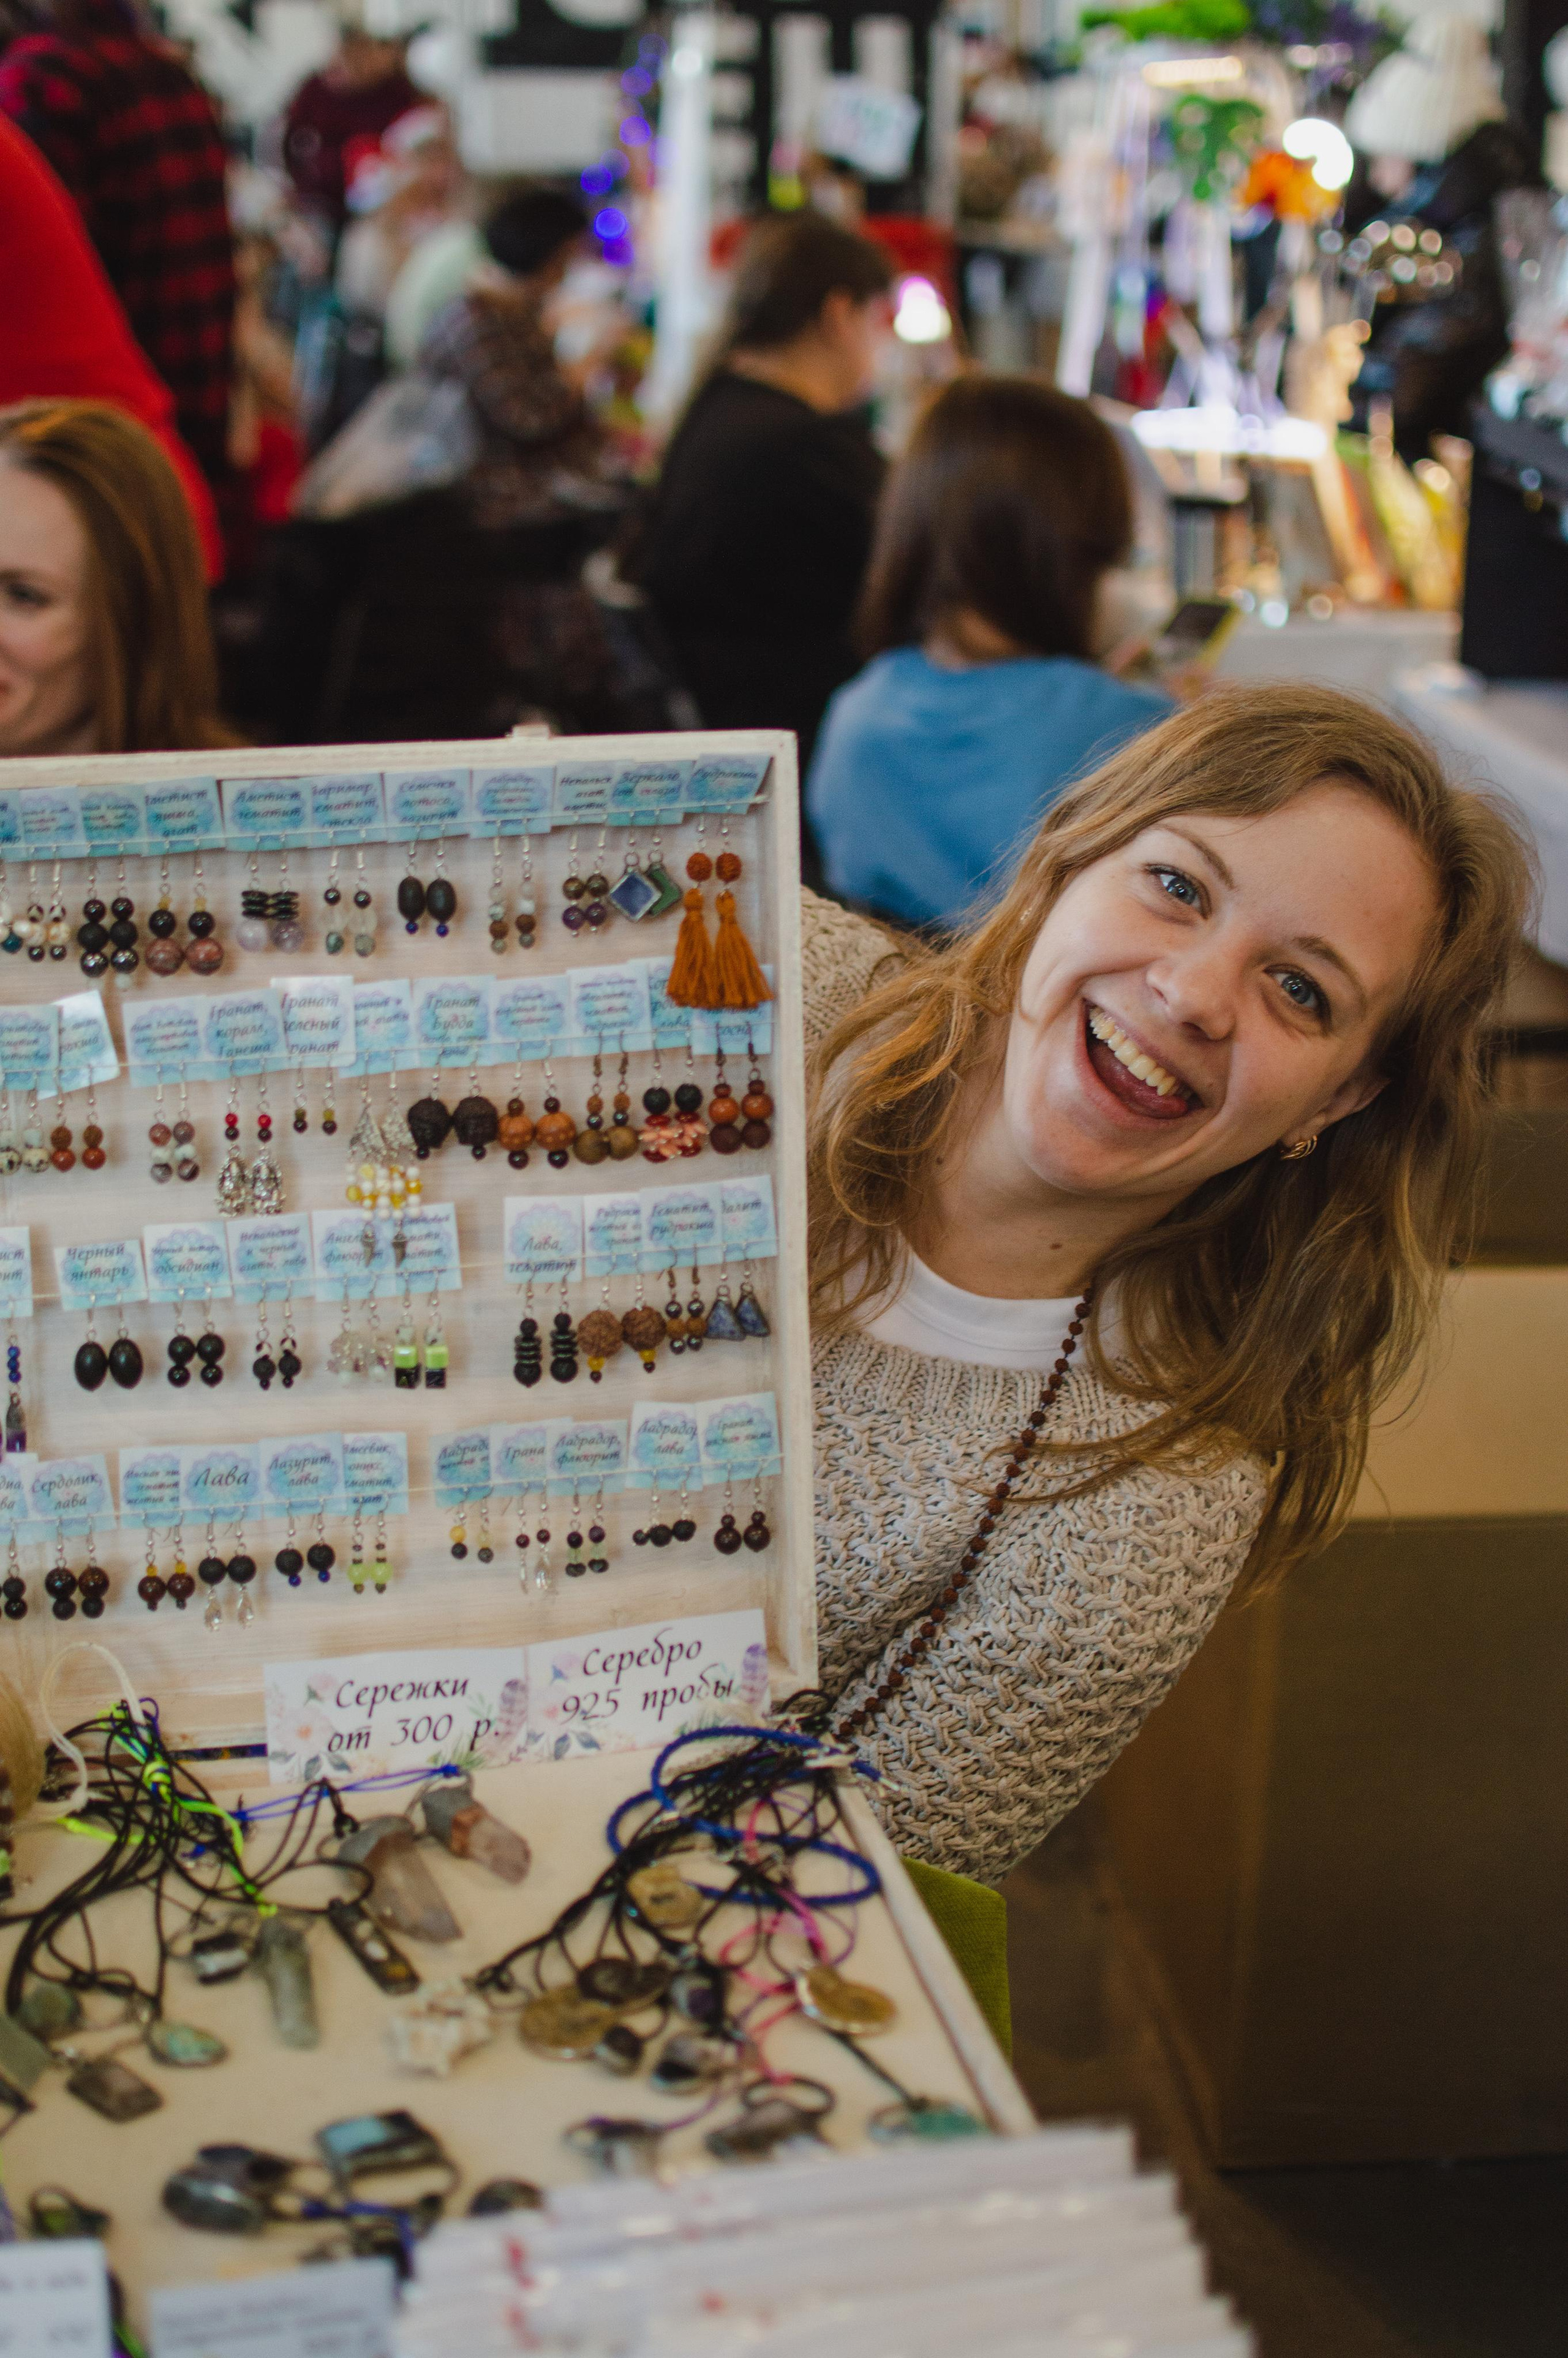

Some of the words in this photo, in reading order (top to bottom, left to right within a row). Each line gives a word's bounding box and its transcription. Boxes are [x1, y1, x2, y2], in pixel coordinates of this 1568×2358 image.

[559, 776, 612, 787] Непальск
[313, 798, 379, 814] ематит,
[281, 992, 339, 1013] Гранат
[428, 992, 481, 1015] Гранат
[289, 1041, 340, 1060] ранат
[505, 1446, 546, 1464] Грана
[194, 1464, 250, 1487] Лава
[287, 1472, 319, 1487] лава
[54, 1493, 88, 1511] лава
[582, 1627, 703, 1683] Серебро
[335, 1676, 471, 1718] Сережки
[562, 1687, 620, 1726] 925
[641, 1663, 734, 1721] пробы
[327, 1726, 371, 1753] от
[391, 1714, 454, 1747] 300
[469, 1716, 500, 1751] р.
